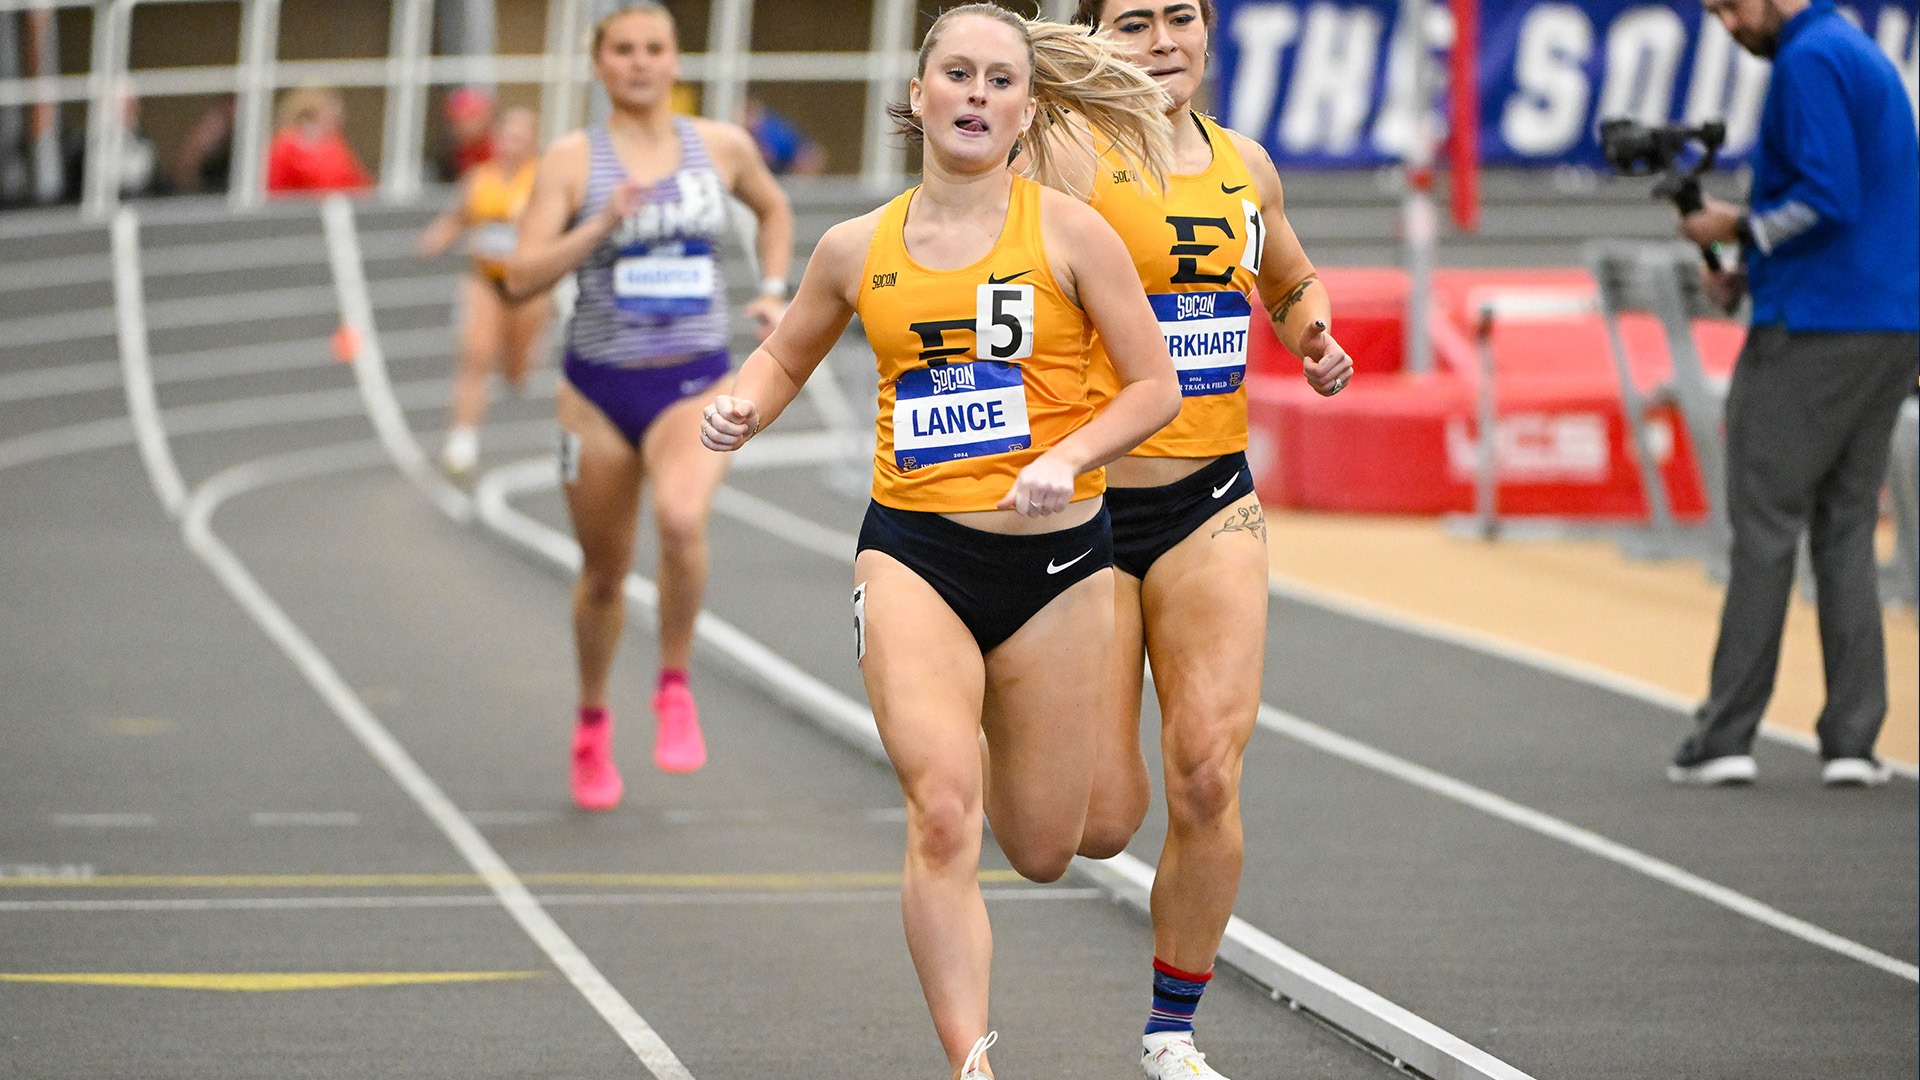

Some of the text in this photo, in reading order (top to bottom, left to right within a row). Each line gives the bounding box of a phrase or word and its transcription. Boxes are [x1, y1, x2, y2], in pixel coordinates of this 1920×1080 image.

[1165, 215, 1236, 287] E
[1249, 210, 1261, 271] 1
[990, 289, 1023, 358] 5
[1184, 383, 1206, 391] TRACK
[1211, 381, 1228, 389] FIELD
[912, 400, 1006, 437] LANCE
[953, 451, 969, 459] 2024
